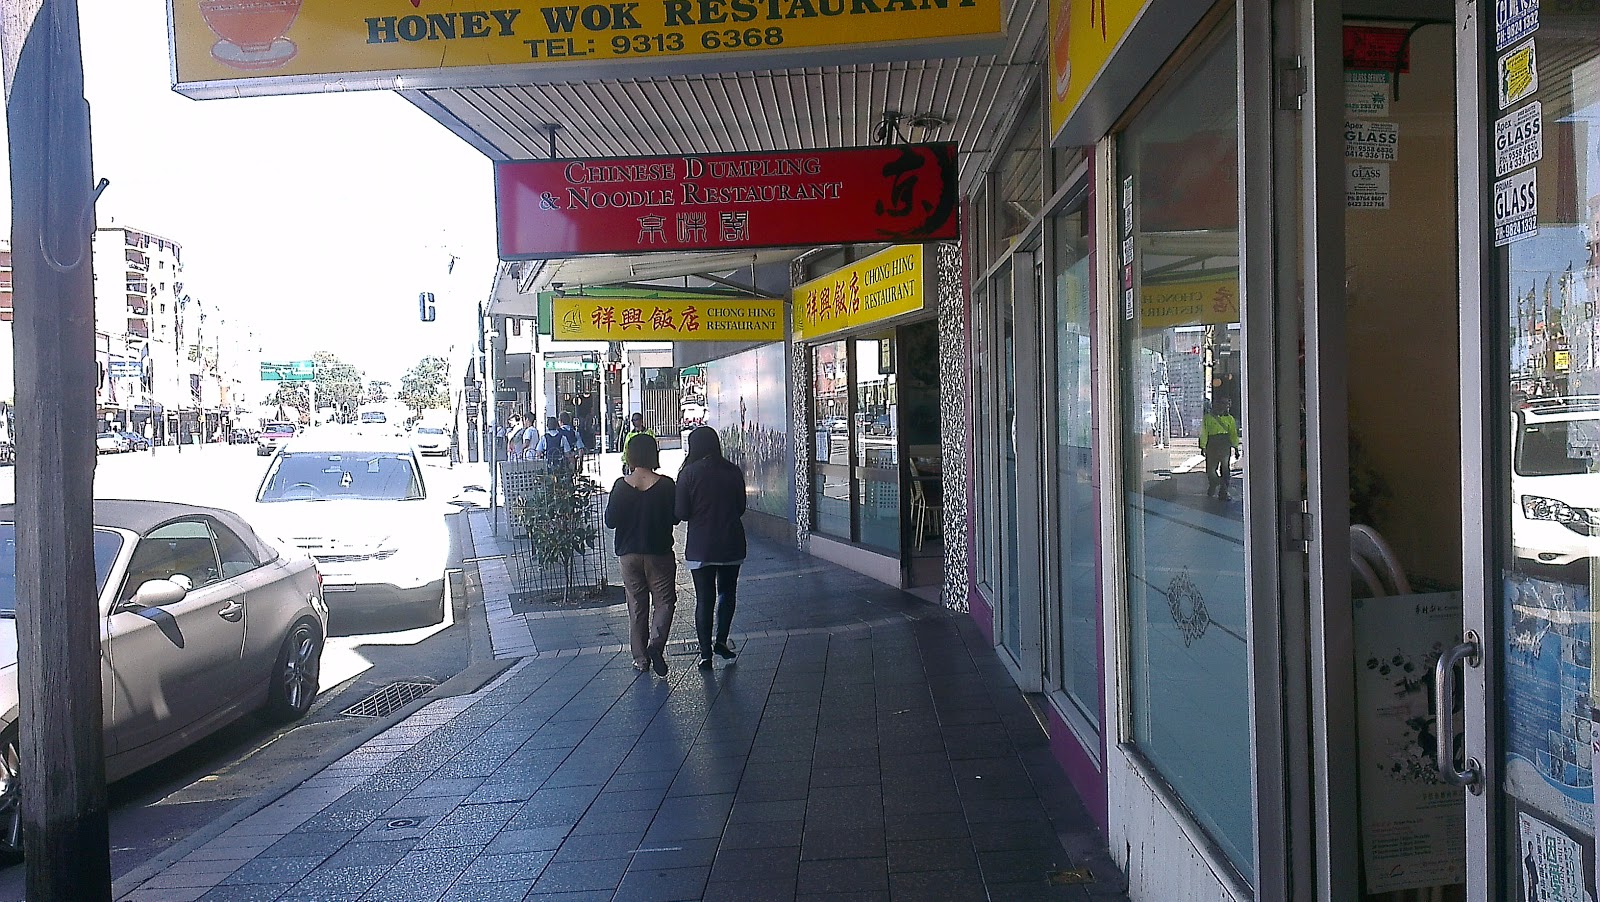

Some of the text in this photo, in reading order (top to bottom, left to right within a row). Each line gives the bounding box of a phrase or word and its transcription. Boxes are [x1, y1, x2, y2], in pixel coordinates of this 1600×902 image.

[364, 0, 977, 44] HONEY WOK RESTAUR
[523, 26, 784, 58] TEL: 9313 6368
[1344, 130, 1397, 144] GLASS
[1345, 121, 1363, 130] Apex
[1497, 118, 1540, 150] GLASS
[564, 156, 822, 184] CHINESE DUMPLING
[1352, 168, 1381, 178] GLASS
[1498, 161, 1513, 175] 0414
[539, 182, 843, 211] & NOODLE RESTAURANT
[1496, 181, 1535, 219] GLASS
[1521, 216, 1537, 232] 1332
[864, 254, 914, 286] CHONG HING
[806, 271, 860, 328] 祥興飯店
[864, 279, 915, 310] RESTAURANT
[591, 305, 701, 333] 祥興飯店
[706, 321, 777, 331] RESTAURANT
[707, 308, 776, 318] CHONG HING
